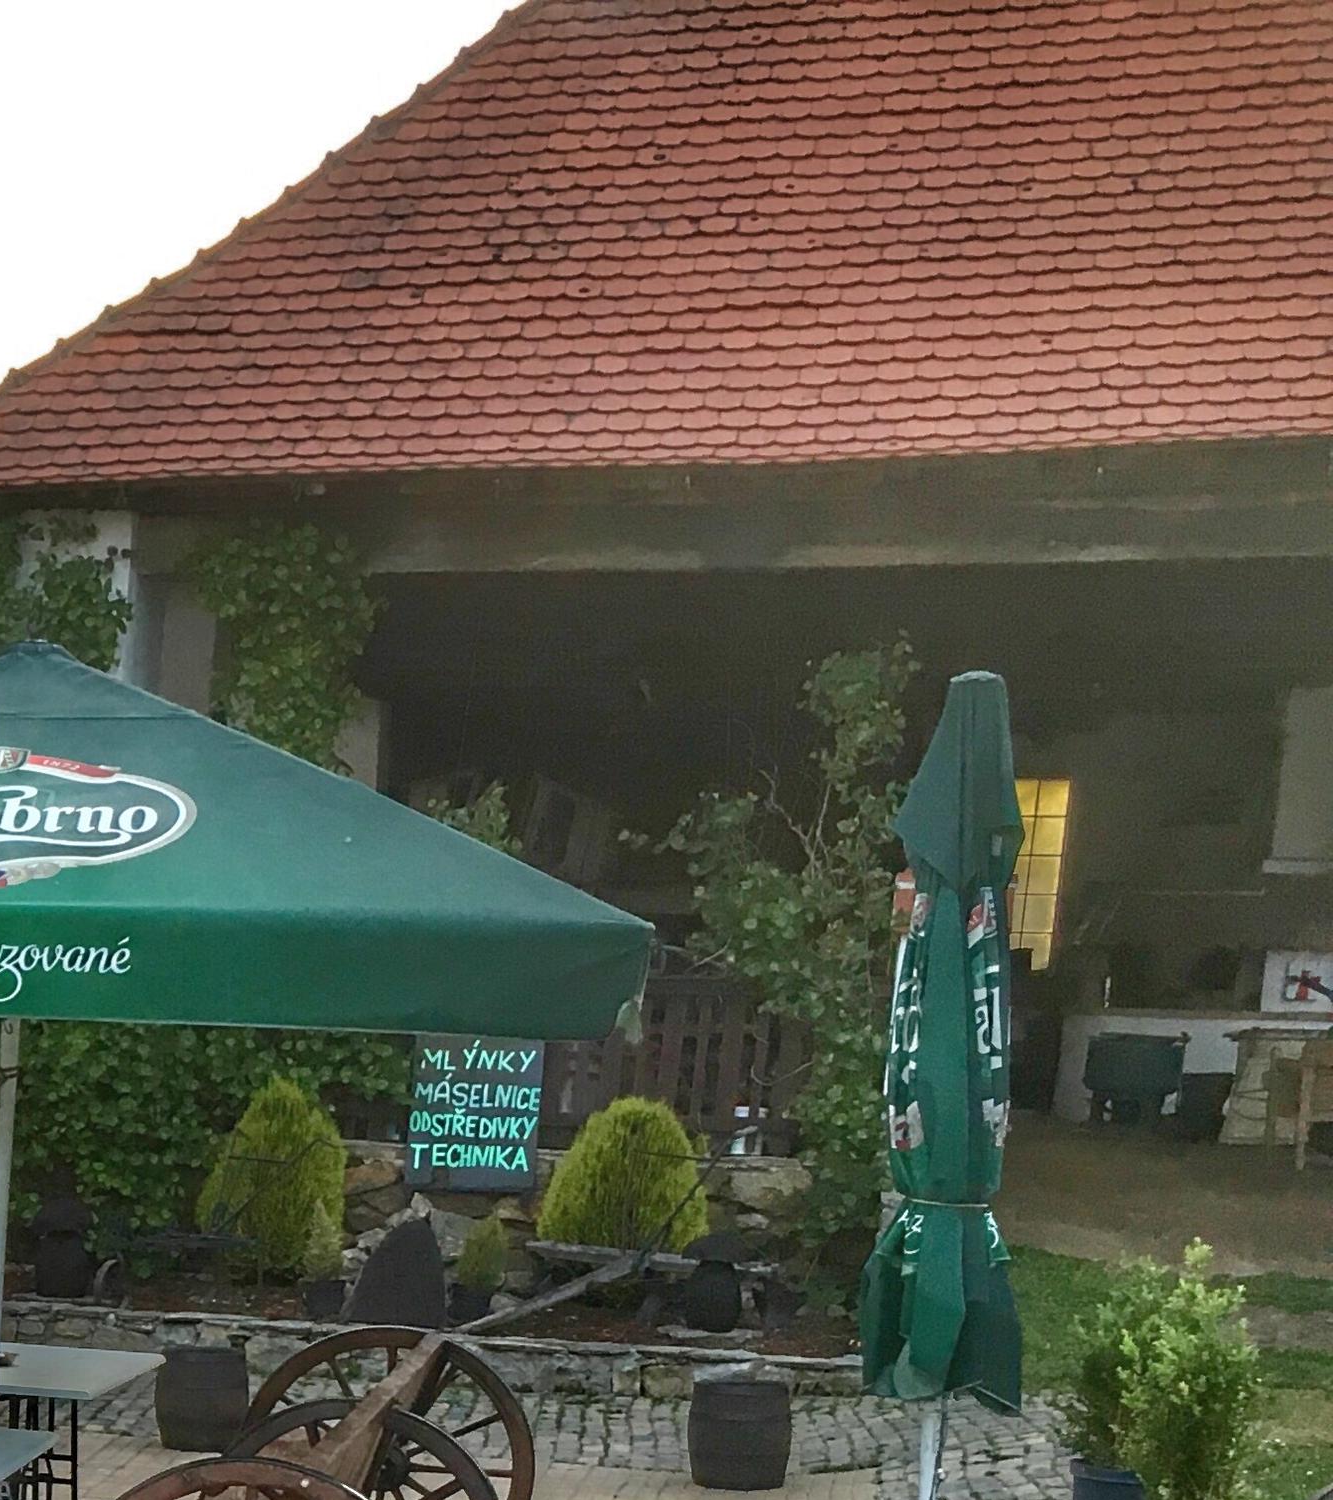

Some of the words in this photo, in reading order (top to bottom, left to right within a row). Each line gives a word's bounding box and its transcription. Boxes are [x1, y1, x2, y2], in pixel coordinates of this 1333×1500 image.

[414, 1072, 542, 1112] MÁSELNICE
[409, 1107, 539, 1140] ODSTŘEDIVKY
[410, 1143, 530, 1173] TECHNIKA
